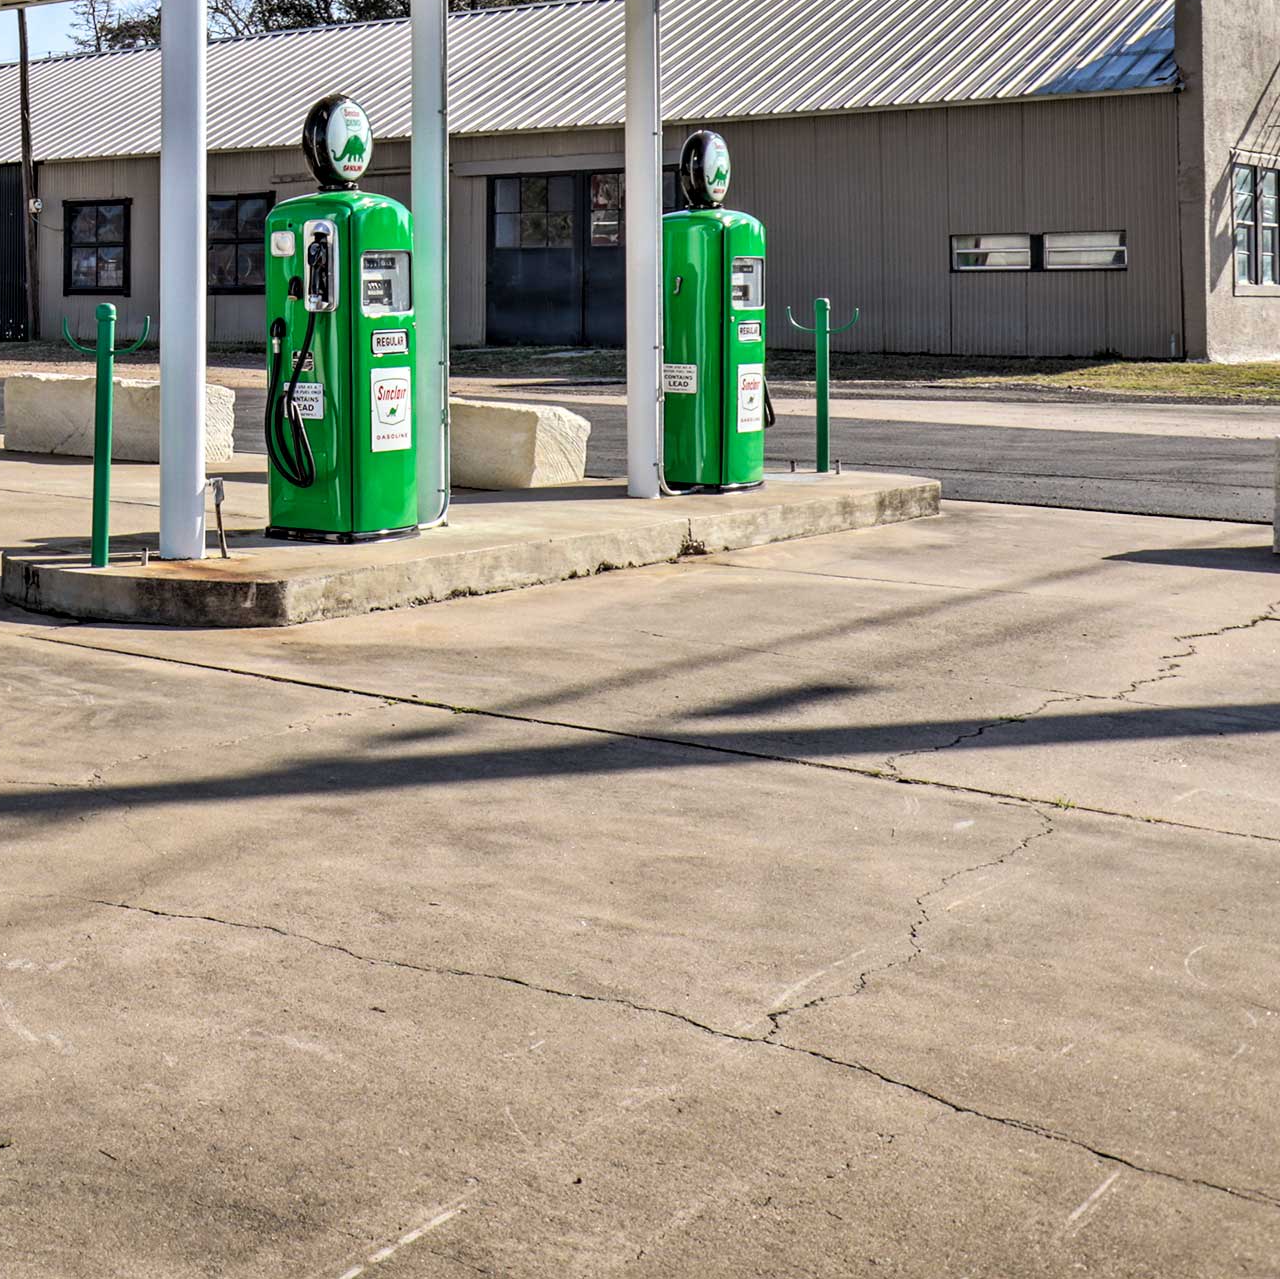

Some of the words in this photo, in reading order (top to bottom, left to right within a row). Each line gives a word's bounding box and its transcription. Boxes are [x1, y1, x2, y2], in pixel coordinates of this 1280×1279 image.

[376, 336, 404, 348] REGULAR
[668, 380, 689, 388] LEAD
[377, 385, 407, 401] Sinclair
[298, 404, 315, 412] EAD
[376, 433, 408, 441] GASOLINE
